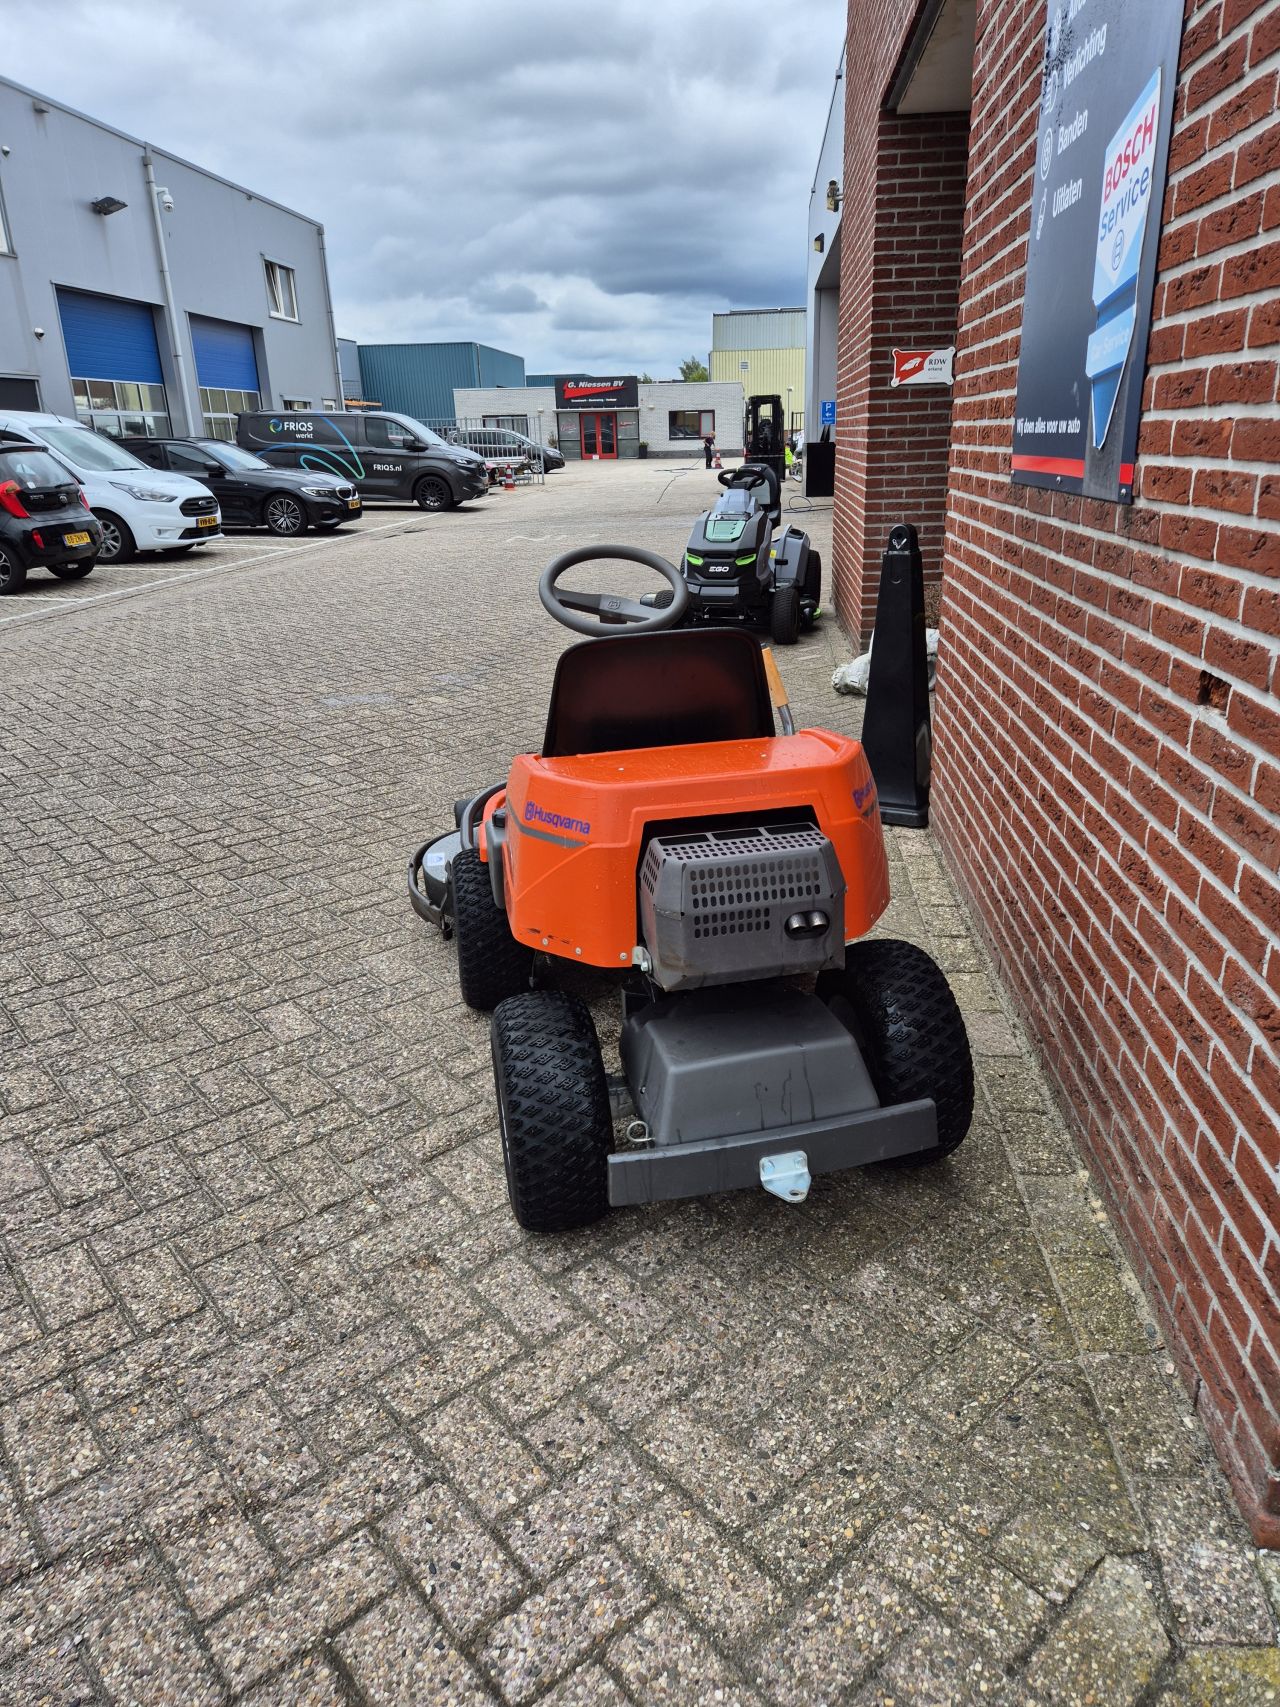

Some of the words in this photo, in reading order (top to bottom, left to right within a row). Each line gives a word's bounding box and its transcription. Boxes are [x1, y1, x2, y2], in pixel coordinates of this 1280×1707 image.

[1063, 23, 1107, 90] Verlichting
[1057, 109, 1088, 155] Banden
[1103, 103, 1156, 204] BOSCH
[1052, 178, 1083, 218] Uitlaten
[1099, 166, 1150, 242] Service
[928, 358, 947, 366] RDW
[825, 402, 832, 412] P
[283, 421, 314, 431] FRIQS
[1016, 418, 1024, 437] Wij
[1024, 418, 1035, 434] doen
[1035, 417, 1046, 434] alles
[1046, 420, 1058, 434] voor
[1058, 420, 1067, 434] uw
[1067, 417, 1081, 434] auto
[373, 463, 402, 472] FRIQS.nl
[534, 805, 591, 835] Husqvarna
